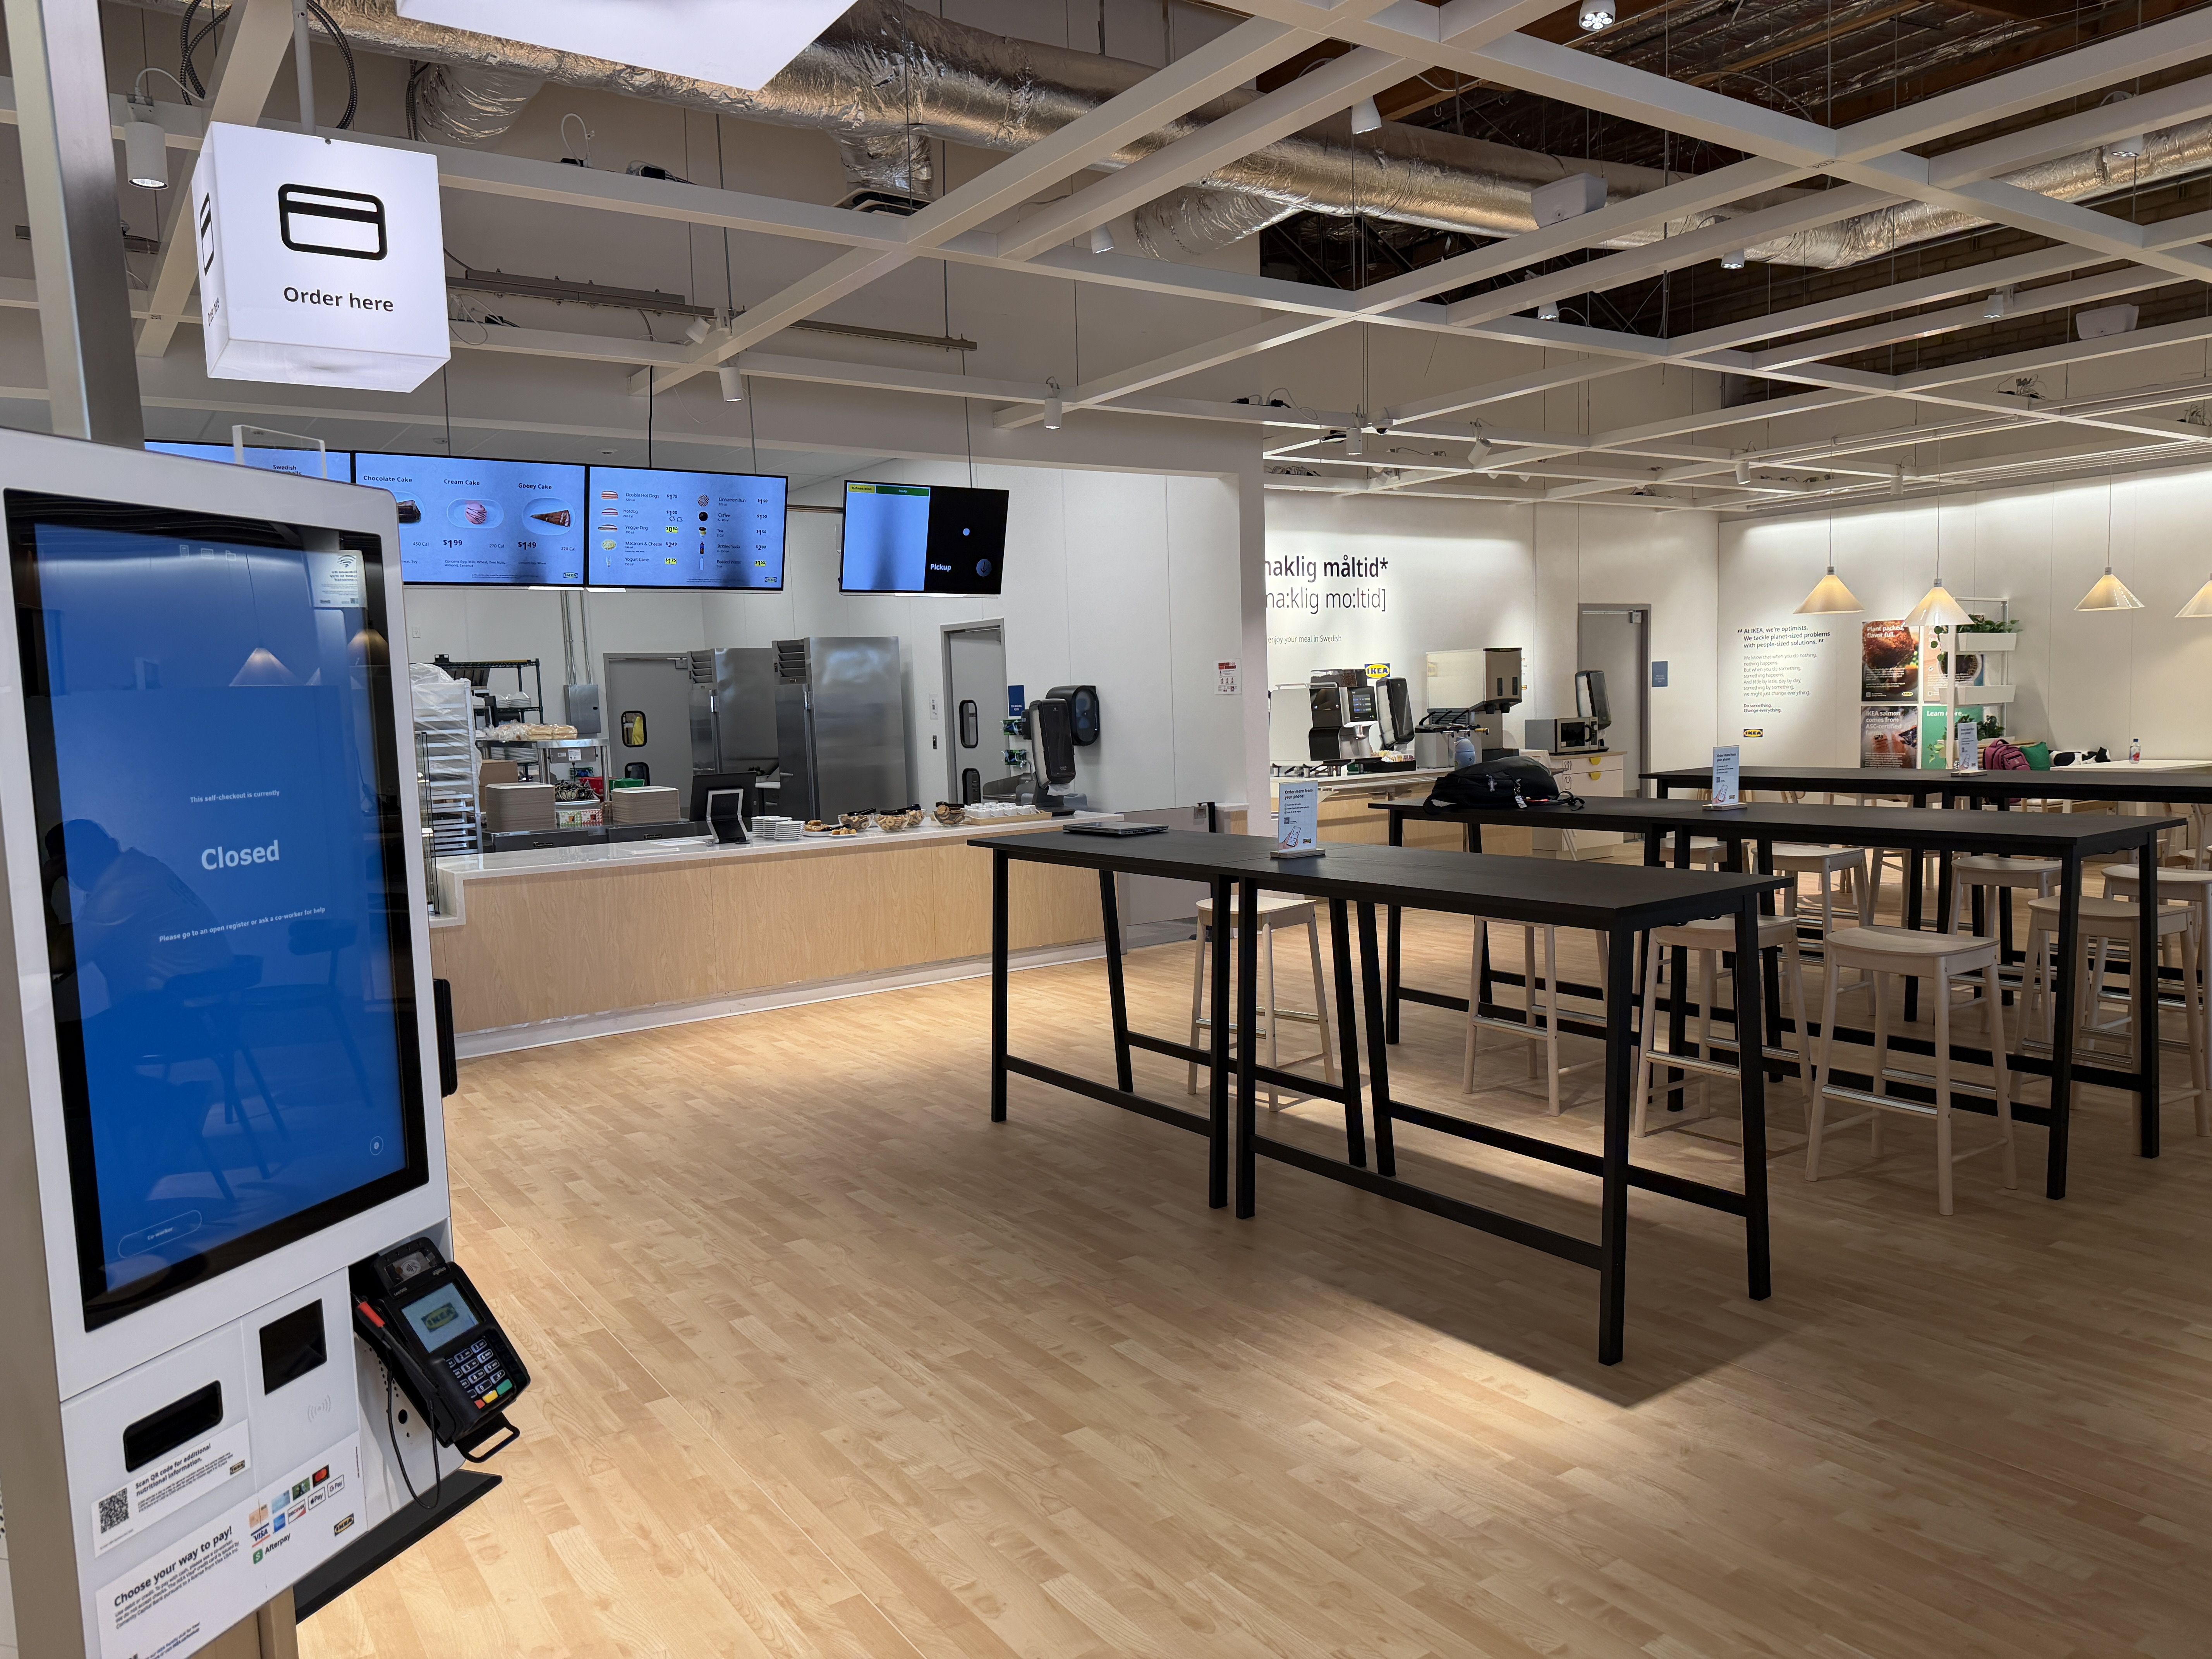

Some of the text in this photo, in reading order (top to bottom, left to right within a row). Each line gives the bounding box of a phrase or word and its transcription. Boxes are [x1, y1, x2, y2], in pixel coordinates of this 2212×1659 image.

[284, 287, 393, 311] Order here
[930, 563, 951, 572] Pickup
[1268, 635, 1283, 645] enjoy
[1284, 636, 1297, 645] your
[204, 793, 246, 801] self-checkout
[201, 839, 280, 870] Closed
[226, 921, 249, 929] register
[275, 912, 302, 920] co-worker
[136, 1478, 149, 1489] Scan
[150, 1472, 158, 1480] QR
[160, 1465, 173, 1475] code
[184, 1443, 210, 1462] additional
[136, 1475, 167, 1496] nutritional
[314, 1493, 323, 1503] Pay
[336, 1518, 353, 1532] IKEA
[253, 1528, 268, 1542] VISA
[265, 1533, 291, 1554] Afterpay
[114, 1527, 232, 1606] Choose your way to pay!
